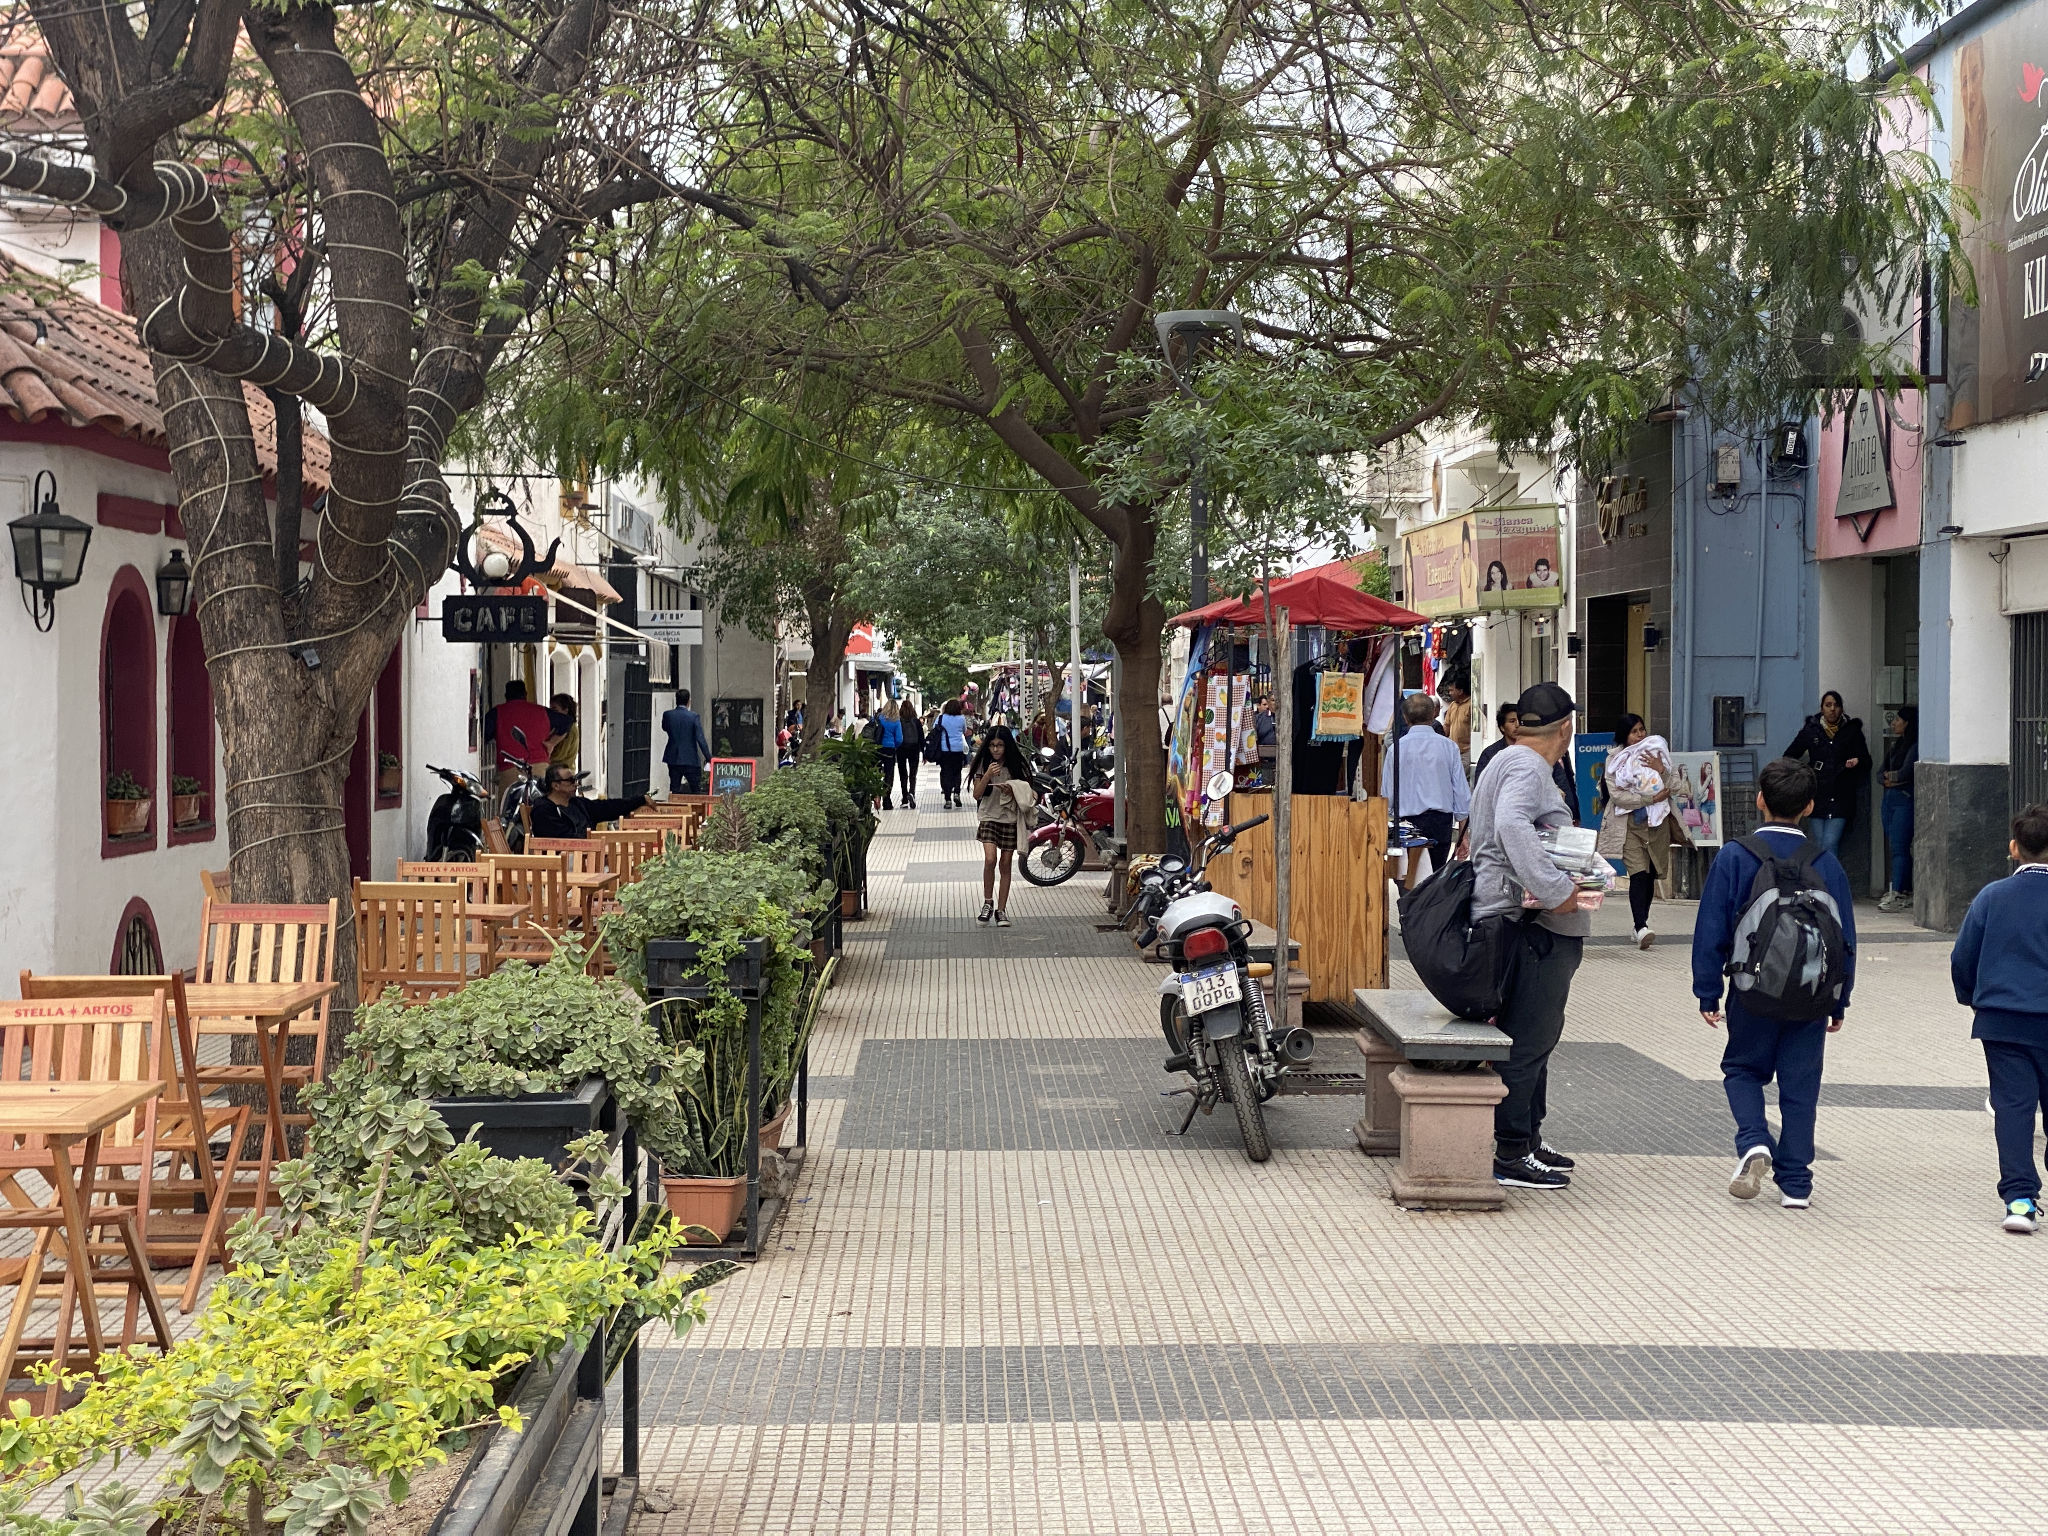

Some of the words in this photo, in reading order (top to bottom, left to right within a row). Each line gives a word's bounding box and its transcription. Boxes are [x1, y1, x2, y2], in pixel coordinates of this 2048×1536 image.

[1850, 435, 1877, 478] INDIA
[454, 606, 536, 632] CAFE
[1195, 973, 1226, 997] A13
[14, 1007, 64, 1018] STELLA
[81, 1004, 133, 1017] ARTOIS
